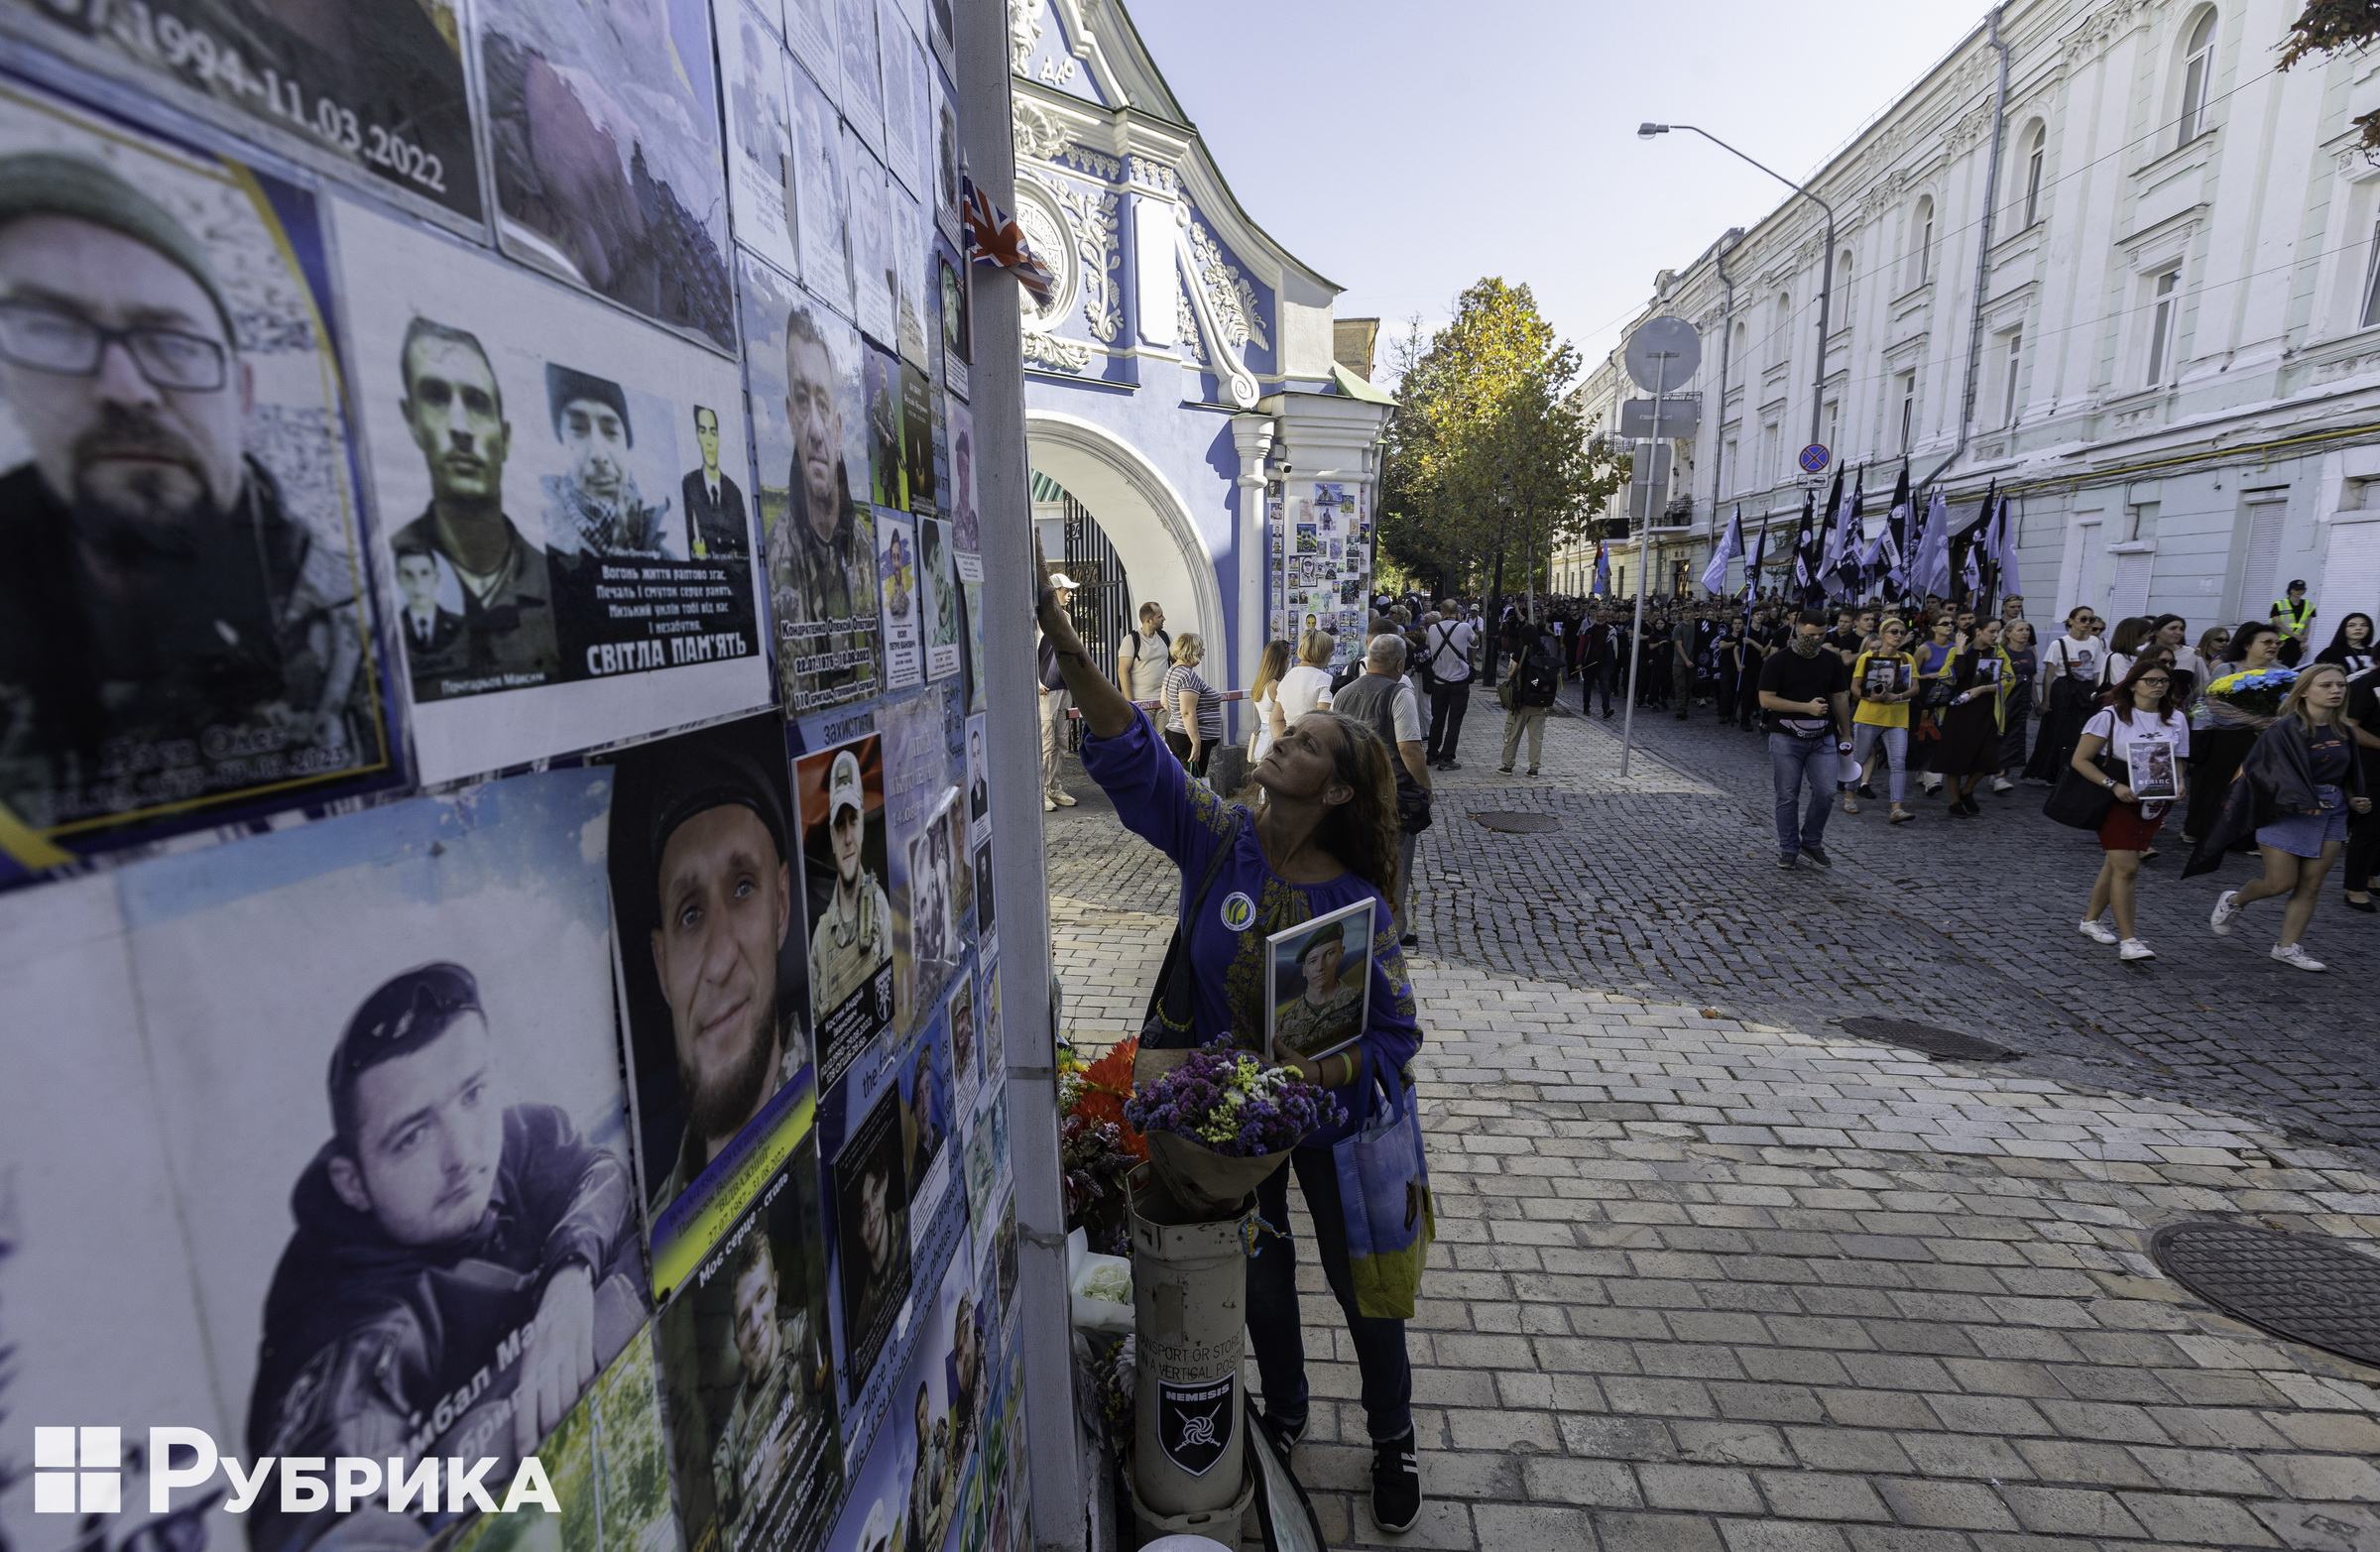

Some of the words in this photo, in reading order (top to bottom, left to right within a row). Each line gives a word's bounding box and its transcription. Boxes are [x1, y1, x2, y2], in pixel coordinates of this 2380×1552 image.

[596, 585, 636, 599] Печаль
[645, 586, 678, 599] смуток
[680, 587, 703, 598] серце
[602, 564, 640, 580] Вогонь
[642, 568, 671, 580] життя
[673, 569, 707, 581] раптово
[654, 604, 680, 618] уклін
[682, 602, 700, 615] тобі
[701, 602, 714, 614] від
[716, 601, 729, 613] нас
[586, 640, 666, 675] СВІТЛА
[670, 632, 747, 665] ПАМ'ЯТЬ
[795, 691, 810, 710] 110
[863, 1068, 878, 1094] the
[716, 1150, 757, 1197] Володимир
[757, 1092, 805, 1150] Володимирович
[707, 1196, 746, 1247] 27.07.1987
[752, 1146, 785, 1191] 31.08.2022
[925, 1222, 937, 1252] the
[937, 1177, 958, 1233] project
[698, 1252, 724, 1289] Моє
[725, 1211, 757, 1255] серце
[764, 1172, 789, 1207] сталь
[861, 1363, 888, 1429] place
[889, 1337, 898, 1364] to
[929, 1229, 953, 1283] photos.
[1140, 1349, 1148, 1368] IN
[1149, 1358, 1157, 1373] A
[1158, 1362, 1213, 1381] VERTICAL
[1192, 1346, 1210, 1363] OR
[1165, 1383, 1230, 1402] NEMESIS
[743, 1390, 794, 1492] NOVEMBER
[786, 1416, 807, 1460] Азов
[795, 1428, 832, 1501] Вікторович
